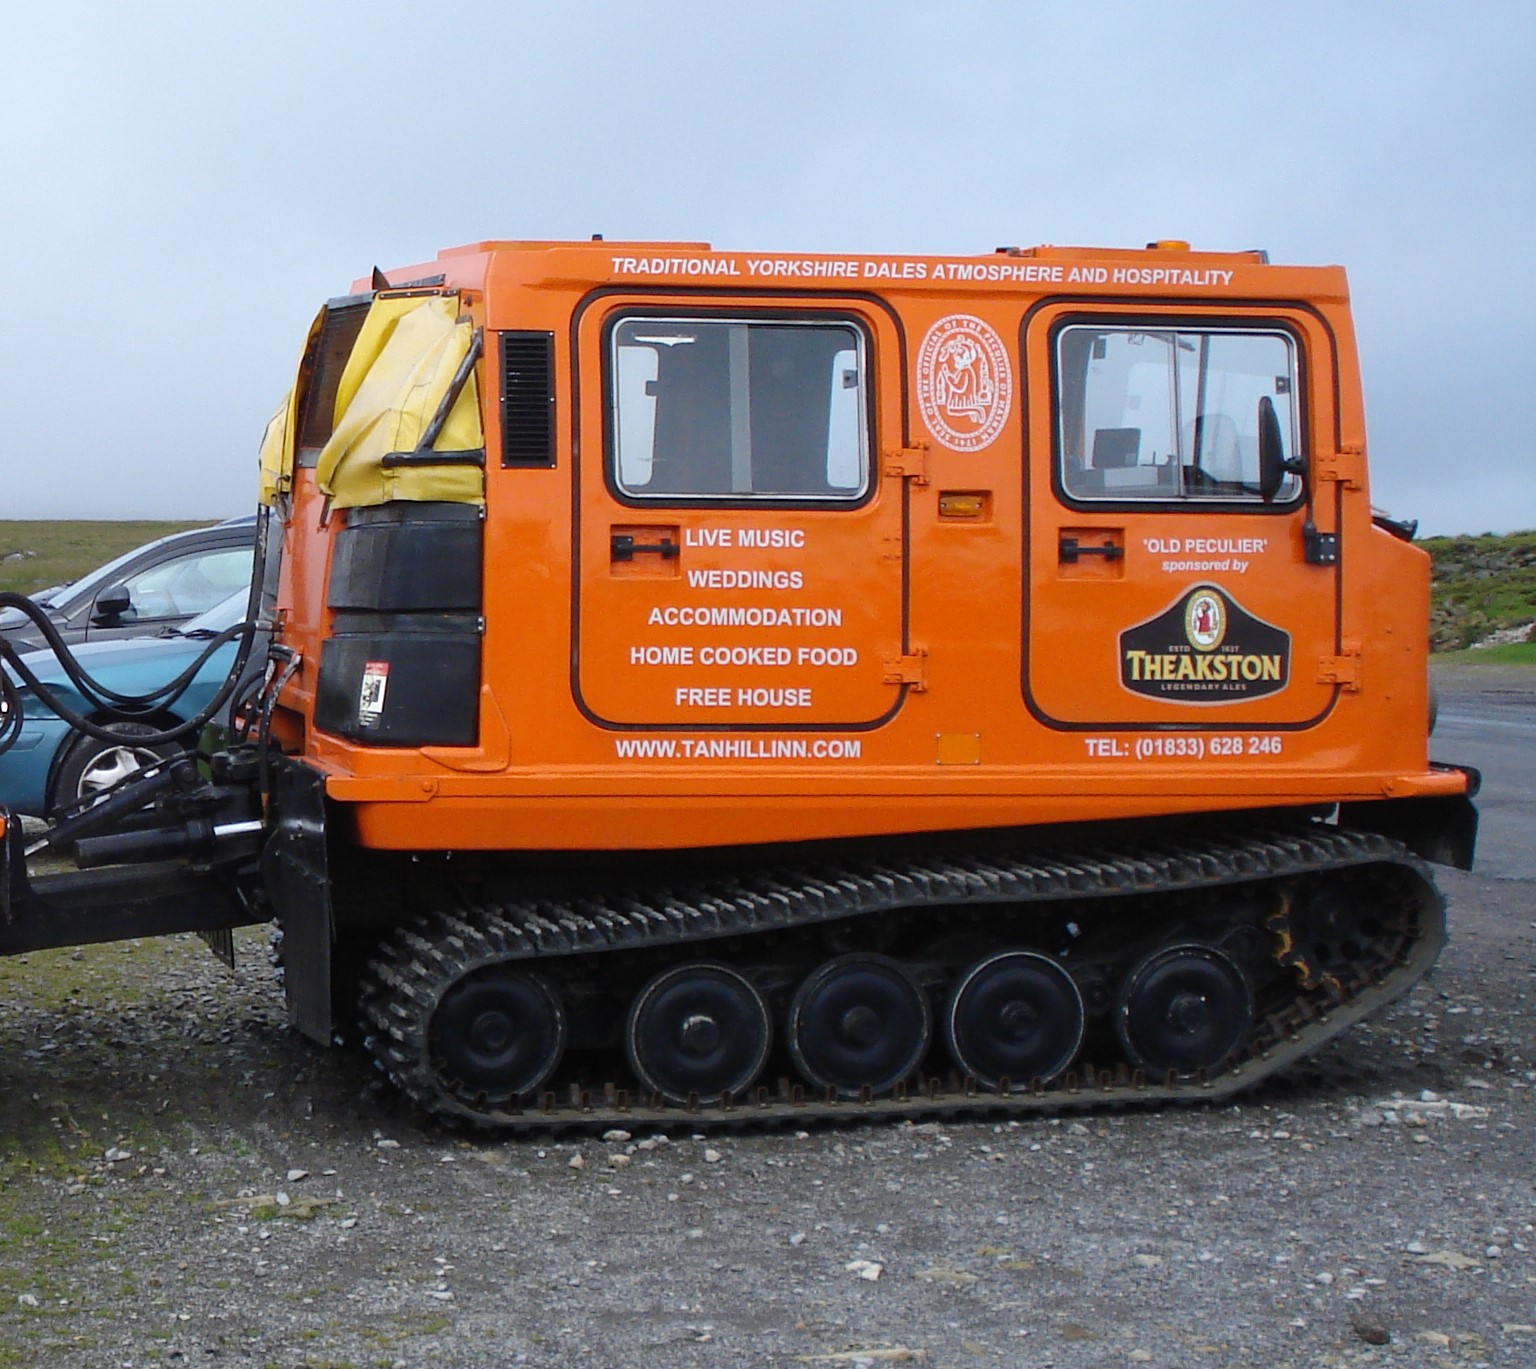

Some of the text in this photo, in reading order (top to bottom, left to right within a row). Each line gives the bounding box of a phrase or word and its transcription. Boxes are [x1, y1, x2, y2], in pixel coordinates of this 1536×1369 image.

[612, 258, 1233, 285] TRADITIONAL YORKSHIRE DALES ATMOSPHERE AND HOSPITALITY
[686, 529, 804, 547] LIVE MUSIC
[1162, 559, 1248, 573] sponsored by
[688, 570, 803, 589] WEDDINGS
[648, 607, 841, 626] ACCOMMODATION
[631, 647, 857, 665] HOME COOKED FOOD
[1126, 650, 1281, 681] THEAKSTON
[1161, 683, 1246, 691] LEGENDARY ALES
[676, 688, 811, 706] FREE HOUSE
[616, 740, 860, 758] WWW.TANHILLINN.COM
[1085, 737, 1281, 759] TEL: (01833) 628 246
